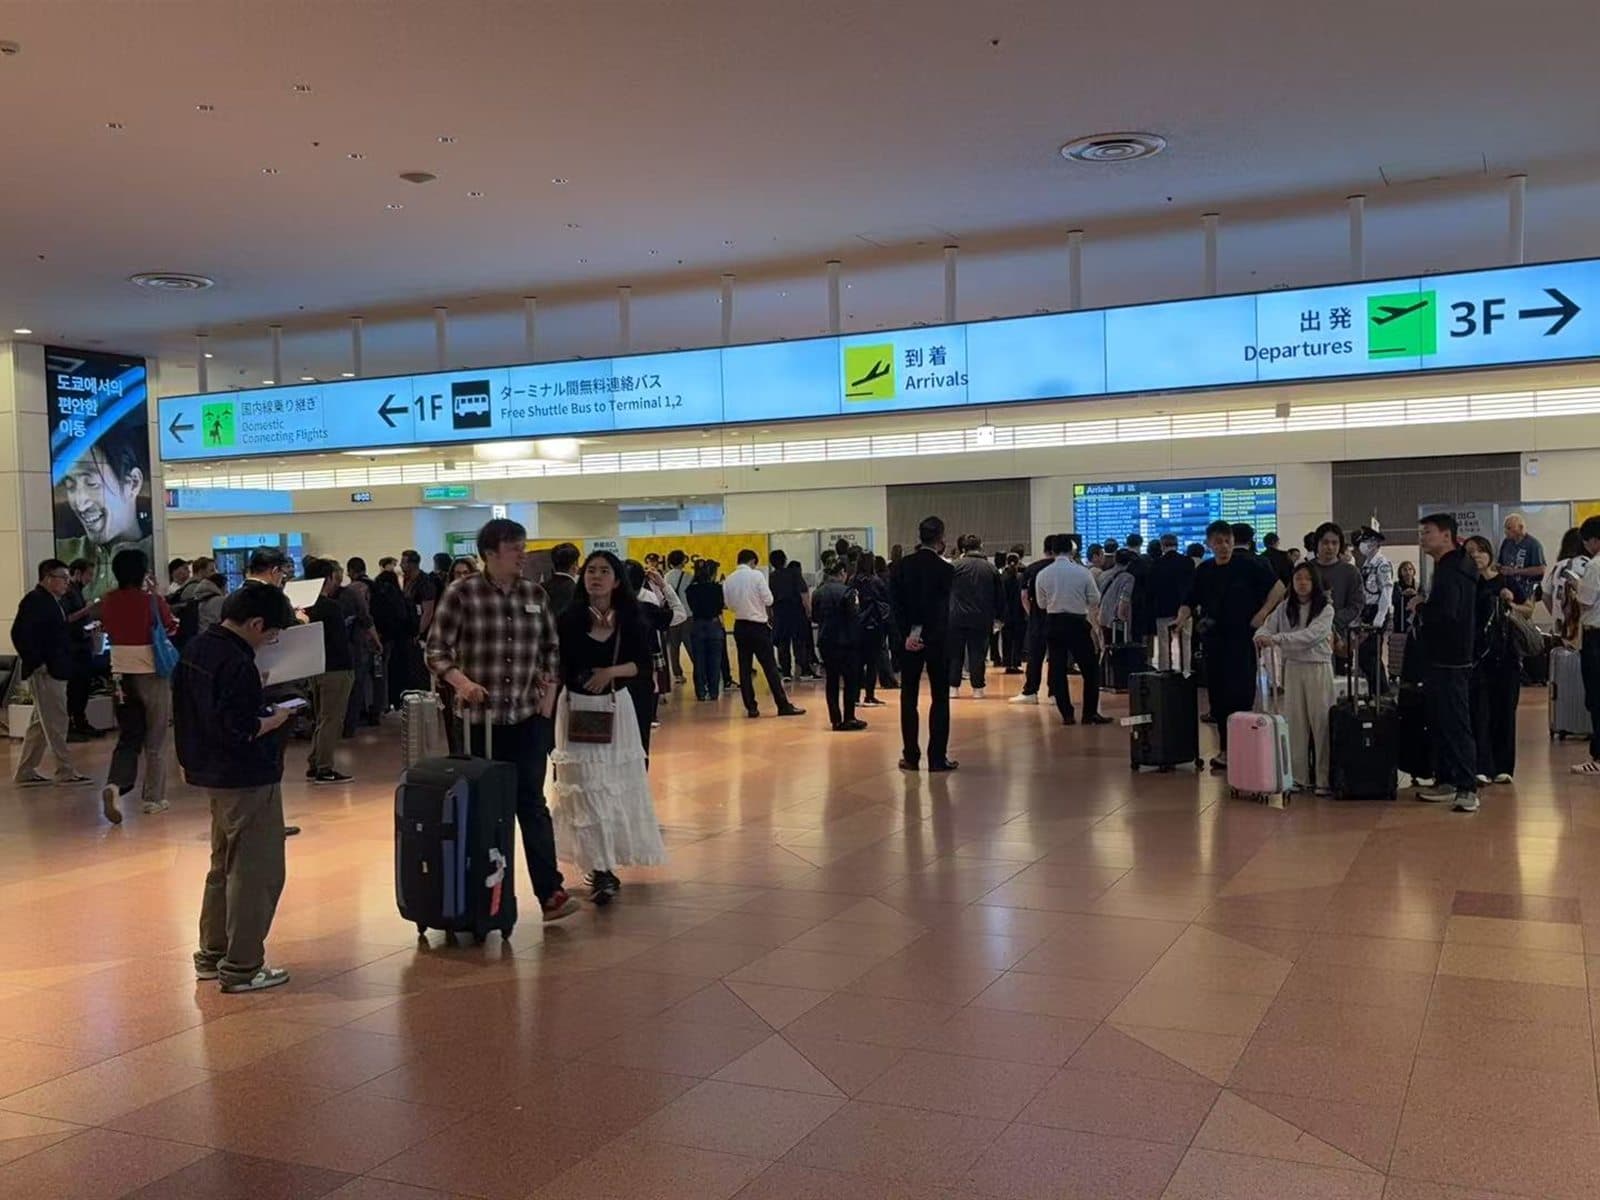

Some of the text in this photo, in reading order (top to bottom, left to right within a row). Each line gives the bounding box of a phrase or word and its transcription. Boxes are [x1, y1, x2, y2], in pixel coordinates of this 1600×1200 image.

[1300, 306, 1352, 333] 出発
[1450, 299, 1507, 337] 3F
[905, 345, 946, 368] 到着
[1244, 340, 1353, 363] Departures
[57, 374, 123, 397] 도쿄에서의
[501, 374, 662, 400] ターミナル間無料連絡バス
[905, 370, 969, 390] Arrivals
[58, 397, 98, 416] 편안한
[414, 394, 444, 421] 1F
[501, 395, 683, 419] Free Shuttle Bus to Terminal 1,2
[59, 419, 87, 437] 이동
[241, 419, 285, 432] Domestic
[241, 427, 329, 444] Connecting Flights
